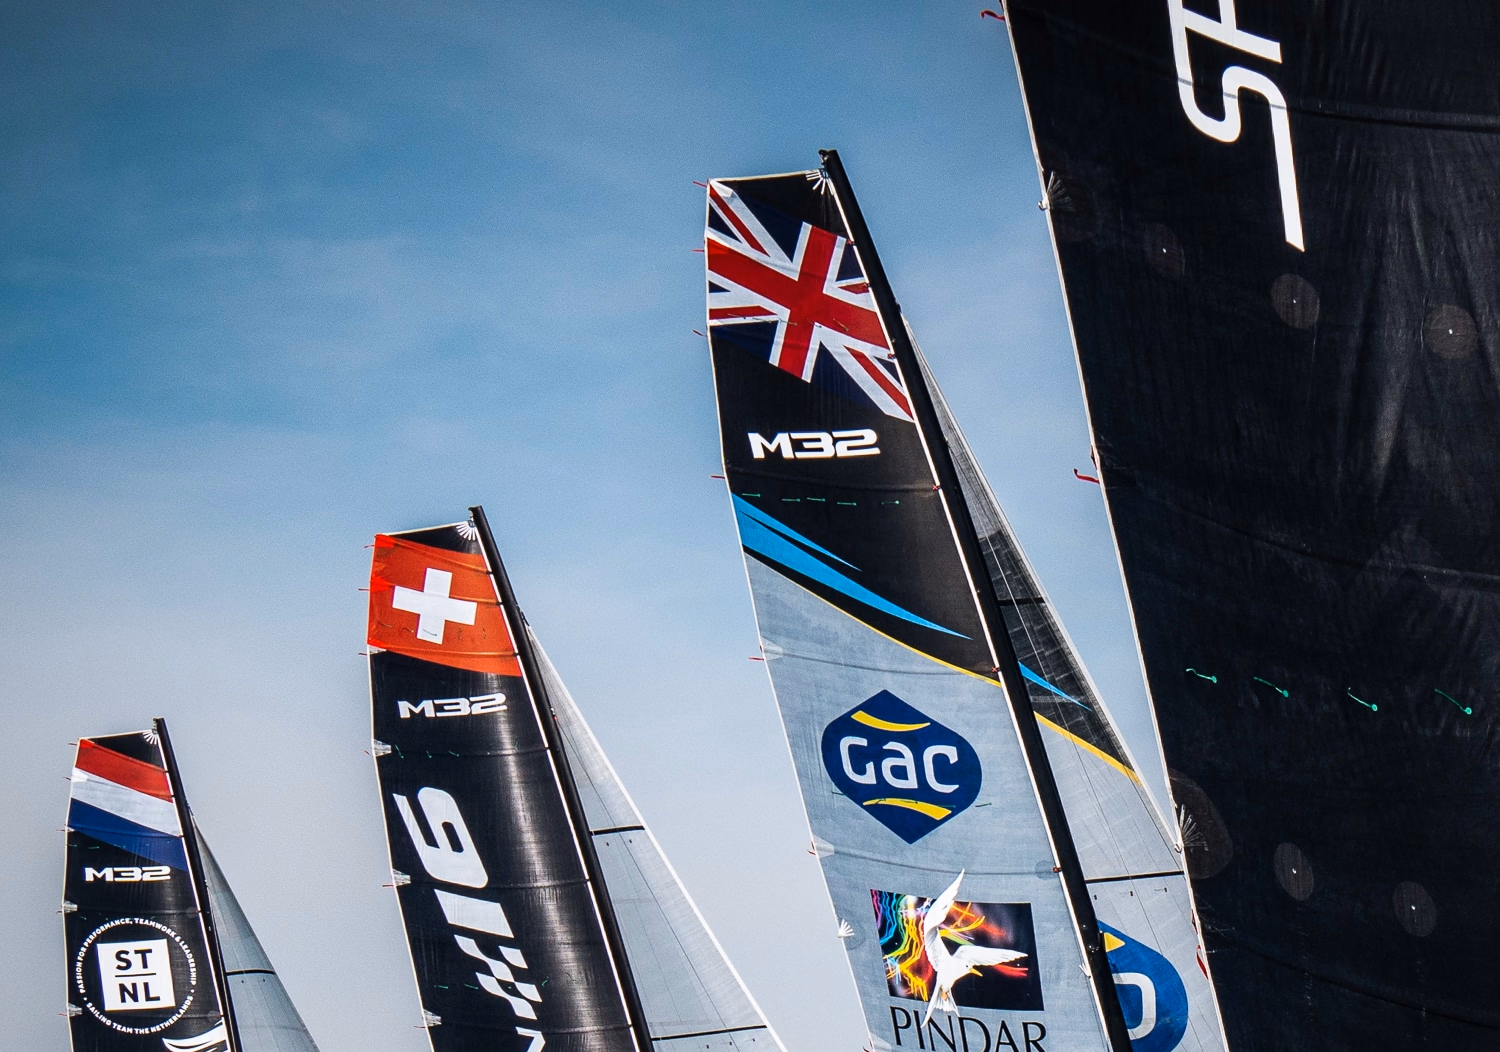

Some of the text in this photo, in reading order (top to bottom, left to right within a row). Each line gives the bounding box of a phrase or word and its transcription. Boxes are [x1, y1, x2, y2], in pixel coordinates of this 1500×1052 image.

[747, 429, 881, 459] M32
[398, 692, 509, 719] M32
[85, 866, 171, 882] M32
[392, 787, 515, 939] 16
[75, 962, 86, 994] PASSION
[133, 917, 179, 939] TEAMWORK
[179, 940, 197, 985] LEADERSHIP
[115, 949, 153, 971] ST
[119, 982, 161, 1004] NL
[86, 995, 194, 1035] SAILING TEAM THE NETHERLANDS
